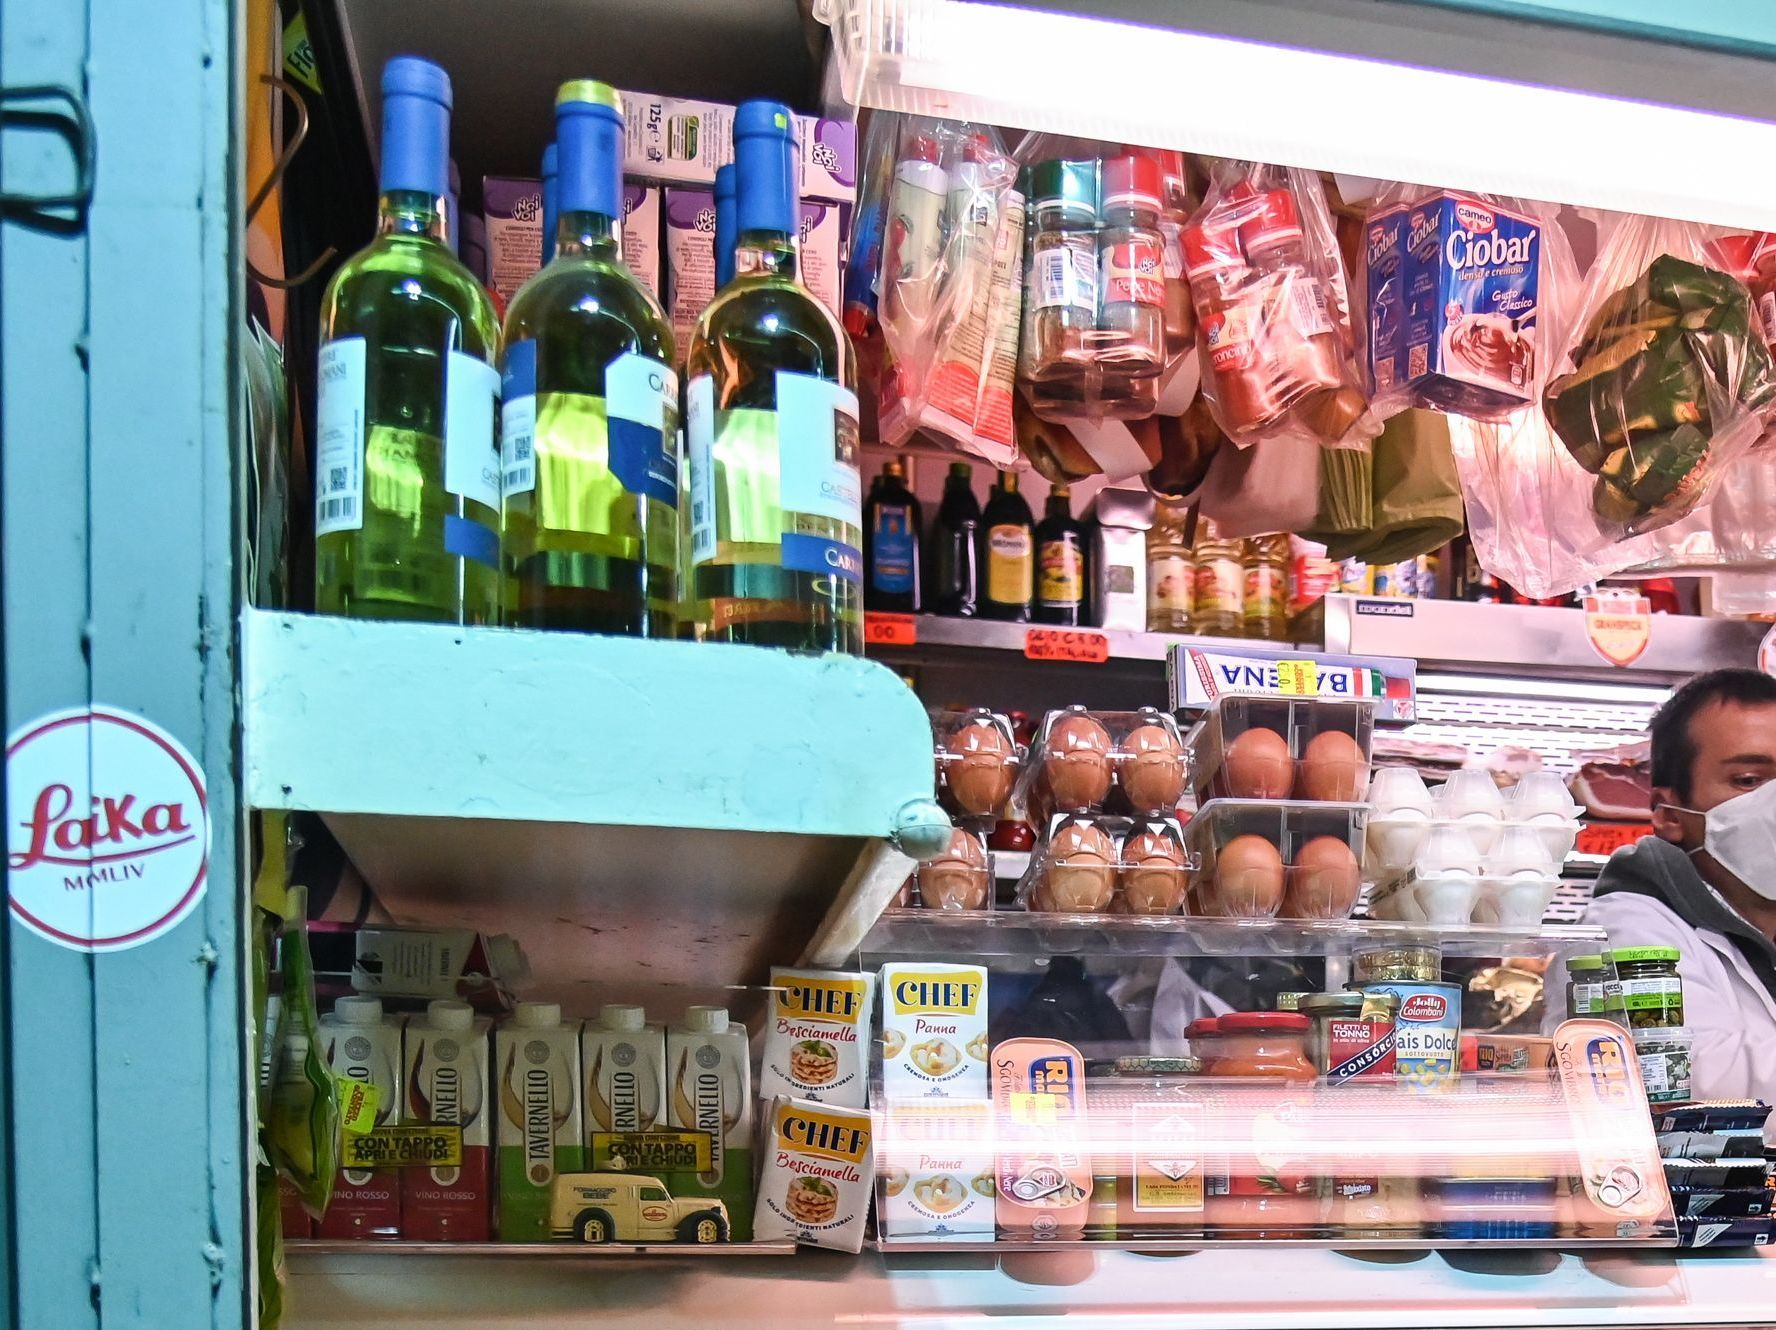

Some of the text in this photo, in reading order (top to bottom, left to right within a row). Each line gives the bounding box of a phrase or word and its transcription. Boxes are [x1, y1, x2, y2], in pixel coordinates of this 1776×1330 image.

[1458, 206, 1492, 225] cameo
[1407, 207, 1442, 253] Ciobar
[1446, 229, 1536, 270] Ciobar
[1492, 288, 1519, 302] Gusto
[1499, 296, 1533, 312] Classico
[63, 864, 146, 892] MMLIV
[779, 986, 862, 1016] CHEF
[895, 981, 977, 1007] CHEF
[1412, 996, 1441, 1009] Jolly
[1403, 1006, 1445, 1017] Colombani
[776, 1018, 857, 1043] Besciamella
[915, 1018, 957, 1035] Panna
[1333, 1024, 1361, 1032] FILETTI
[1333, 1030, 1370, 1039] TONNO
[1396, 1033, 1457, 1050] ais Dolce
[903, 1063, 931, 1082] CREMOSA
[825, 1072, 855, 1091] NATURALI
[527, 1068, 552, 1162] TAVERNELLO
[353, 1137, 448, 1150] CON TAPPO
[782, 1116, 870, 1154] CHEF
[354, 1149, 448, 1160] APRI E CHIUDI
[641, 1143, 697, 1156] TAPPO
[651, 1155, 697, 1166] CHIUDI
[776, 1152, 860, 1183] Besciamella
[919, 1155, 963, 1170] Panna
[352, 1190, 390, 1200] ROSSO
[415, 1190, 476, 1201] VINO ROSSO
[822, 1214, 854, 1231] NATURALI
